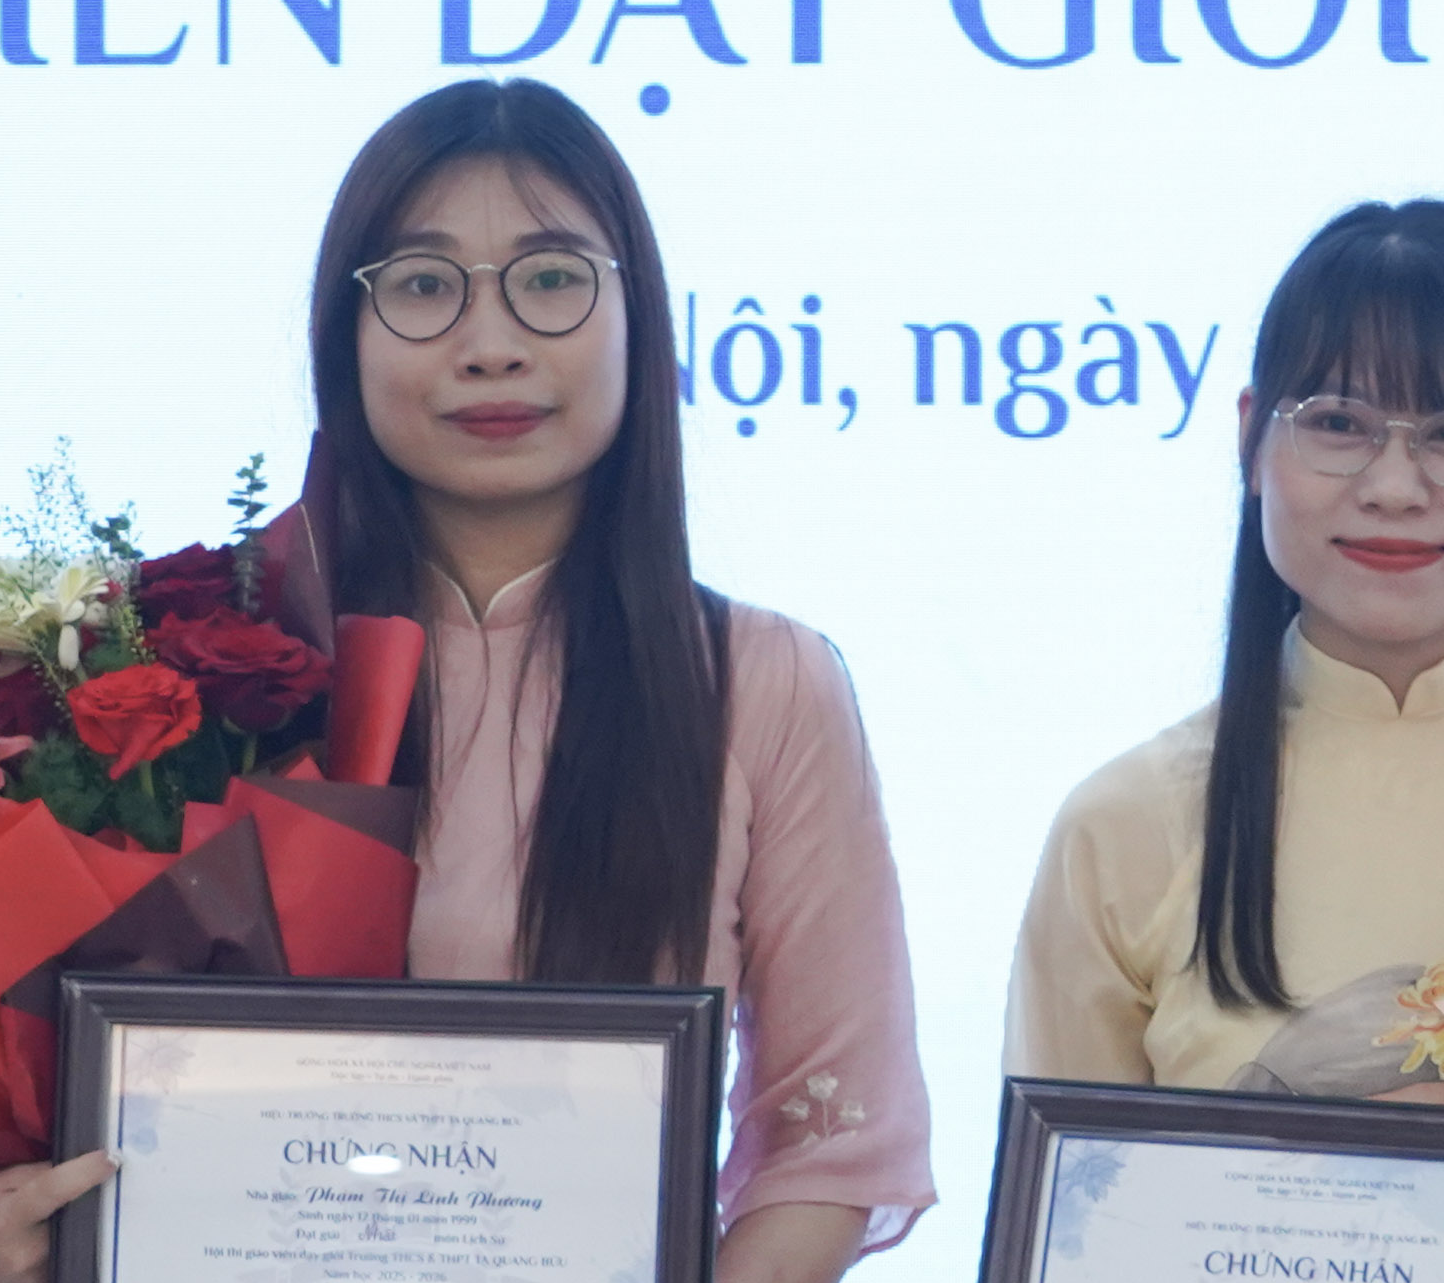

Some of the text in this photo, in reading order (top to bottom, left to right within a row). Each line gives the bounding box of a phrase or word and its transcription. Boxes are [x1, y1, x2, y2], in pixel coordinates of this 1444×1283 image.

[677, 292, 857, 437] ội,
[903, 296, 1220, 439] ngày
[408, 1140, 498, 1175] NHẬN
[375, 1187, 406, 1206] Thị
[413, 1189, 460, 1206] Linh
[466, 1191, 544, 1212] Phương
[1204, 1249, 1316, 1281] CHỨNG
